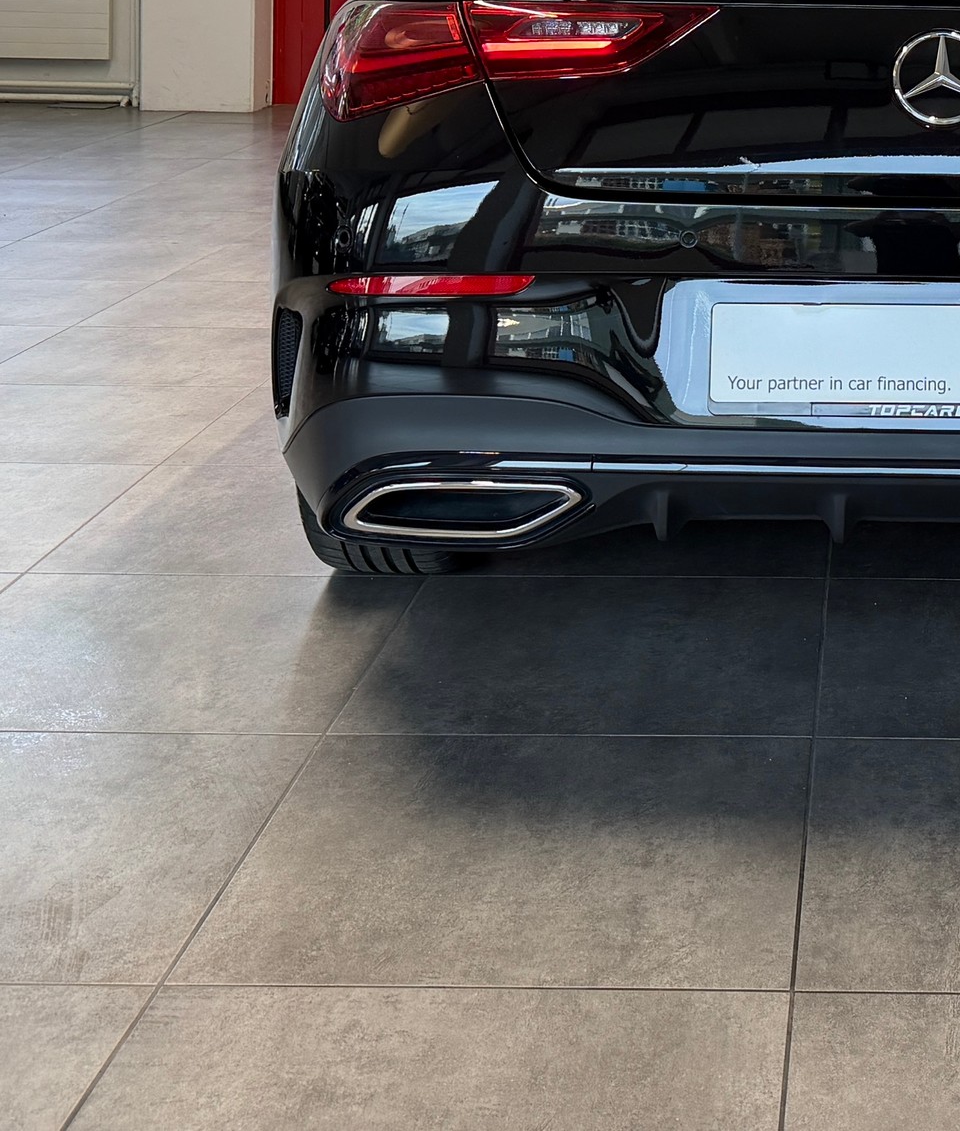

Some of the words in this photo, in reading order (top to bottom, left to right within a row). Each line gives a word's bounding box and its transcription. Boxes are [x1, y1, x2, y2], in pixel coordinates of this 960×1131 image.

[727, 375, 762, 390] Your
[767, 376, 824, 393] partner
[829, 376, 843, 390] in
[848, 379, 872, 391] car
[877, 376, 951, 394] financing.
[868, 404, 954, 417] TOPCAR
